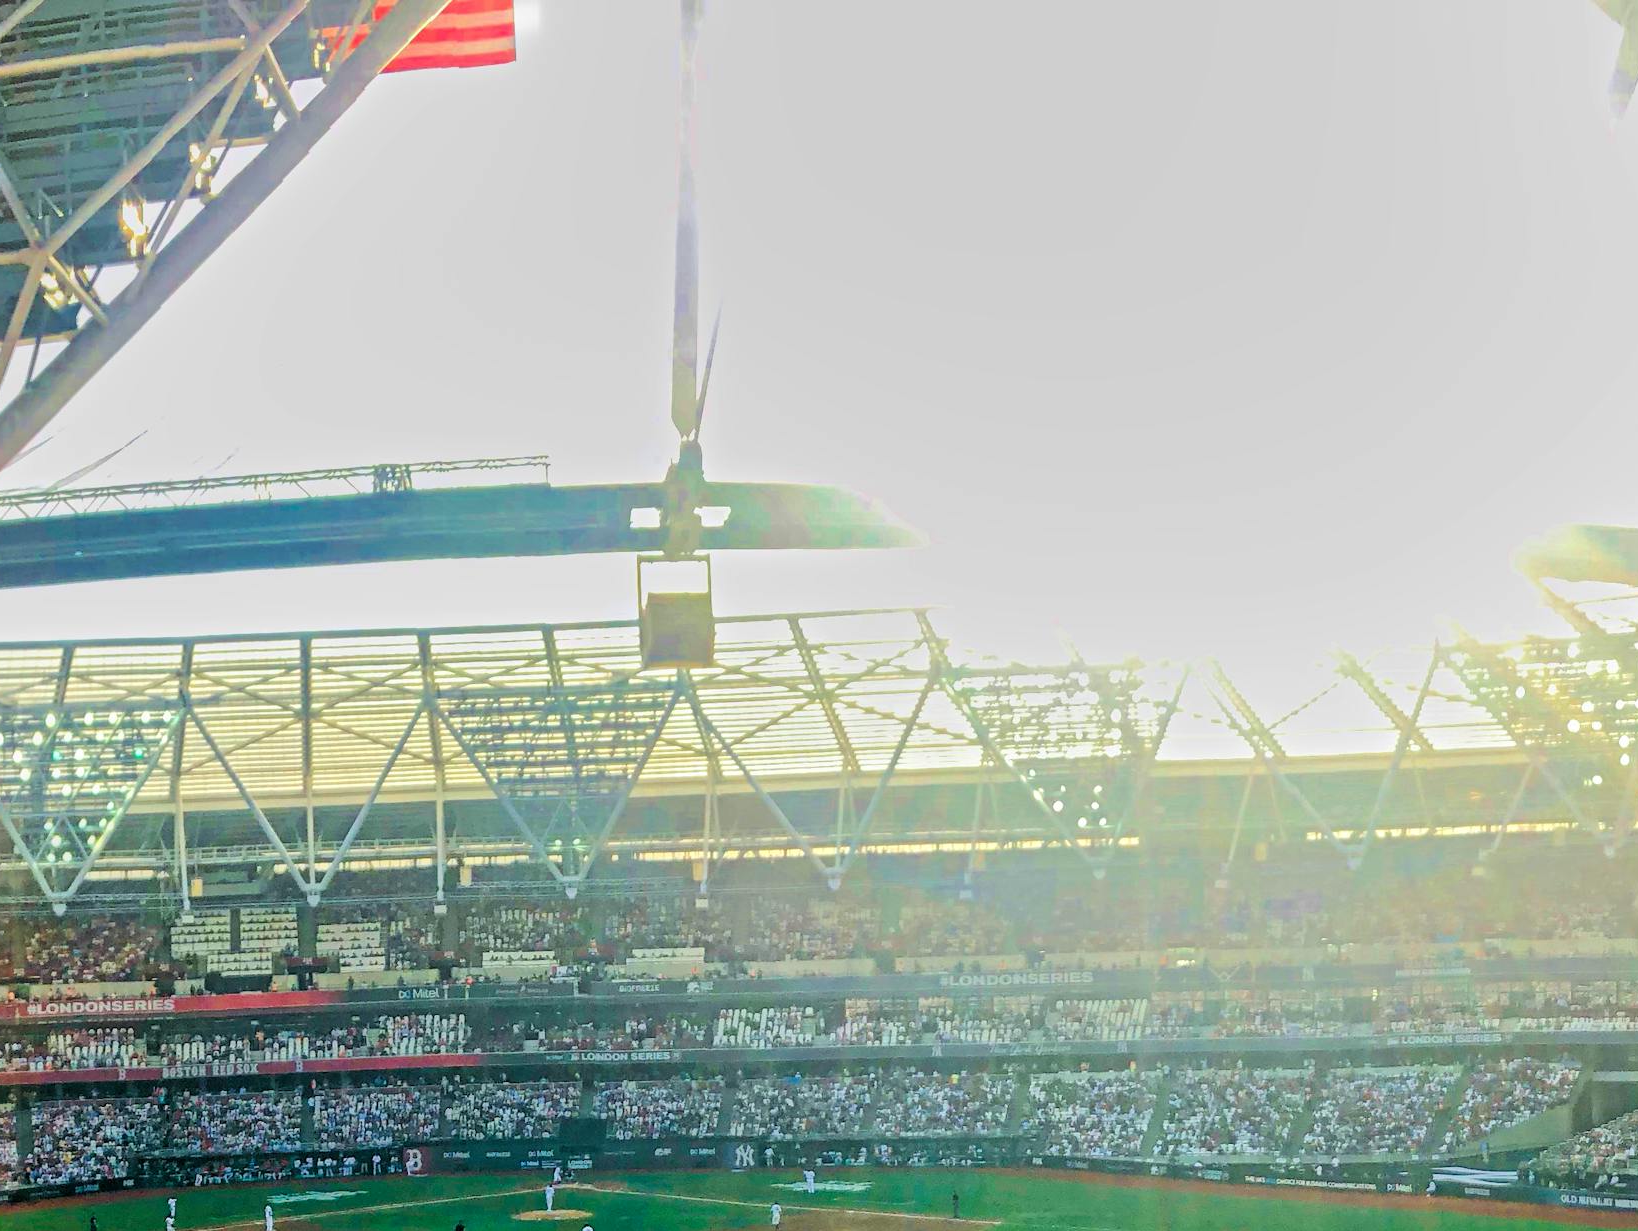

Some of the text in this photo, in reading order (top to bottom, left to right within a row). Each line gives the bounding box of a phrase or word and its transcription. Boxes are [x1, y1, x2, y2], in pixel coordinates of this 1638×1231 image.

[413, 988, 439, 999] Mitel
[28, 999, 175, 1015] #LONDONSERIES
[581, 1051, 670, 1062] LONDON SERIES
[162, 1065, 206, 1079] BOSTON
[212, 1064, 234, 1076] RED
[236, 1063, 259, 1075] SOX
[735, 1144, 755, 1167] NY
[1561, 1195, 1577, 1205] OLD
